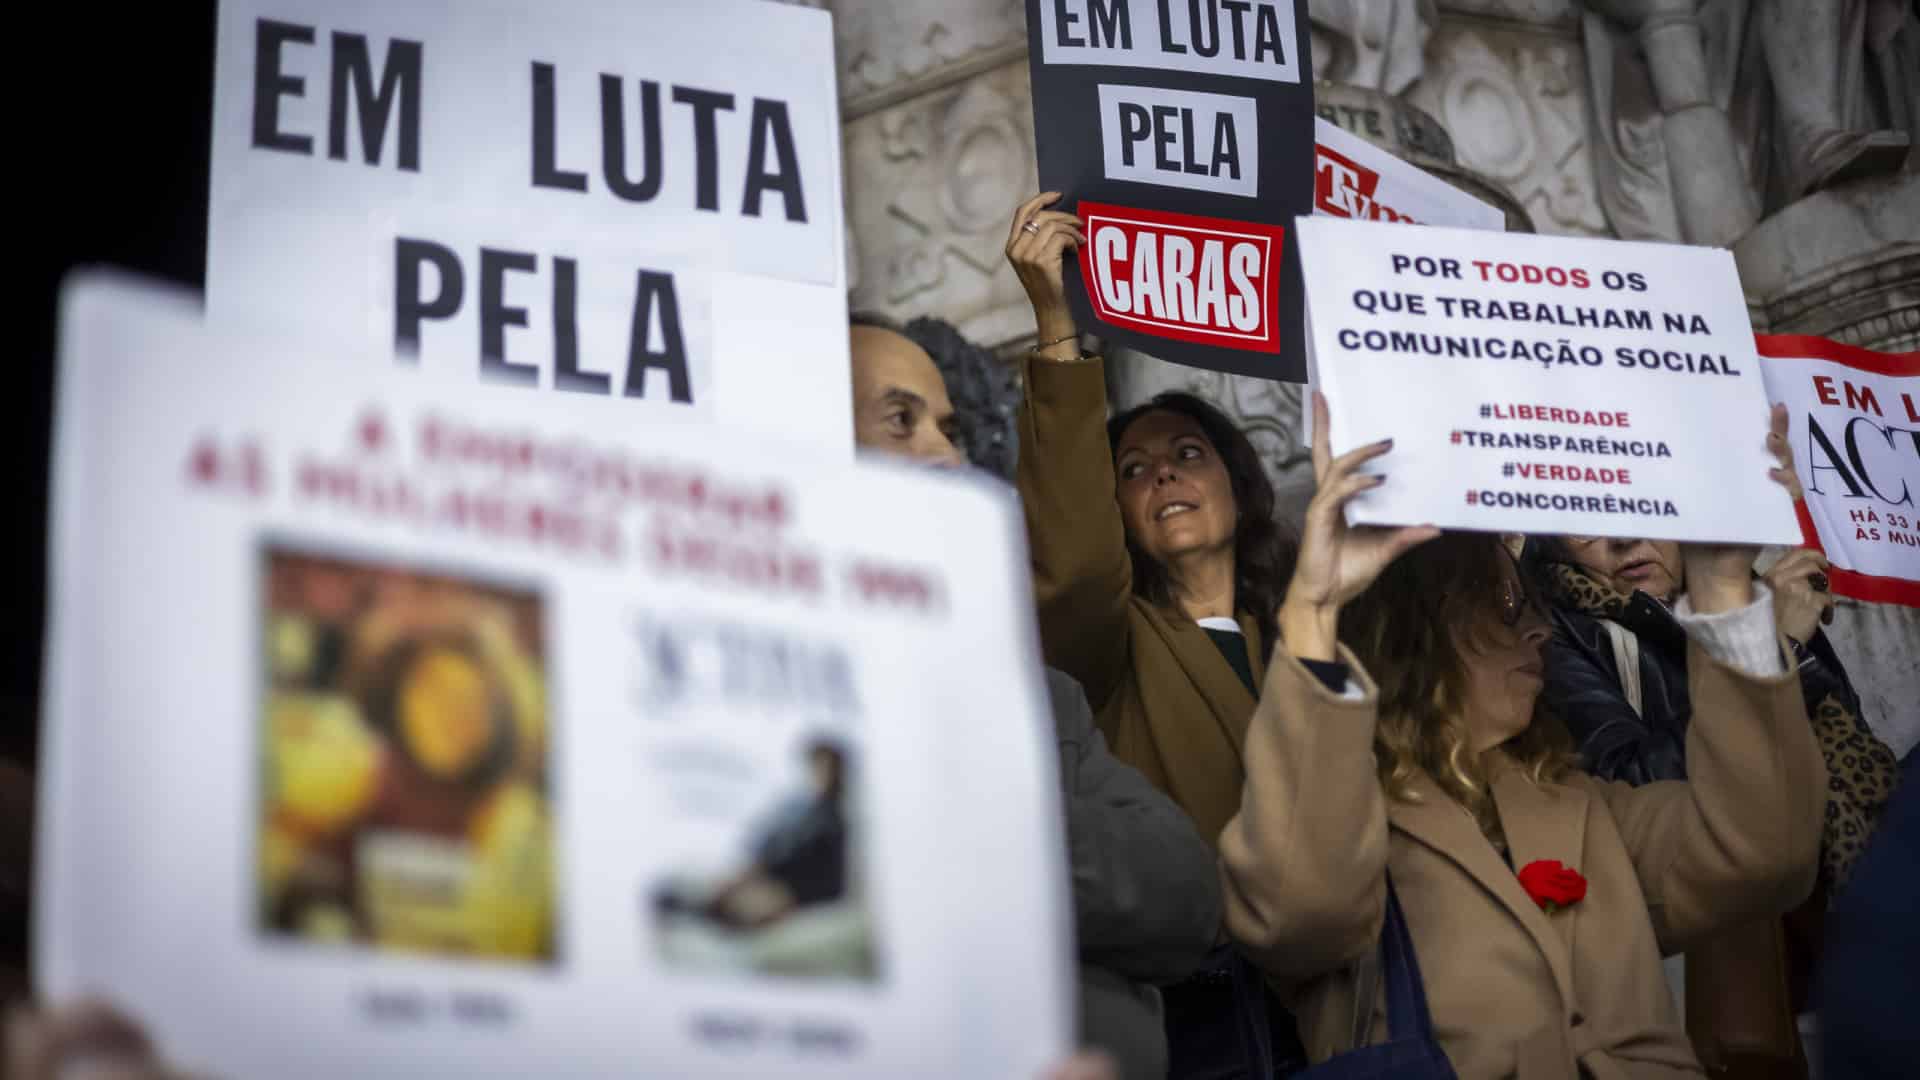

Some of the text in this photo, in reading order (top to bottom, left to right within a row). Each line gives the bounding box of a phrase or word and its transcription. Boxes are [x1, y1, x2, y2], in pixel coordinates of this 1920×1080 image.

[1054, 0, 1287, 66] EM LUTA
[251, 17, 809, 224] EM LUTA
[1118, 101, 1241, 181] PELA
[1095, 226, 1262, 332] CARAS
[1391, 254, 1648, 293] POR TODOS OS
[394, 236, 694, 406] PELA
[1352, 289, 1712, 336] QUE TRABALHAM NA
[1337, 327, 1741, 377] COMUNICAÇÃO SOCIAL
[1479, 403, 1631, 428] #LIBERDADE
[1812, 375, 1884, 417] EM
[1450, 429, 1672, 459] #TRANSPARÊNCIA
[1502, 461, 1632, 484] #VERDADE
[1466, 490, 1679, 517] #CONCORRÊNCIA
[1849, 505, 1880, 523] HÁ
[1886, 513, 1908, 528] 33
[1856, 523, 1920, 547] ÀS MU
